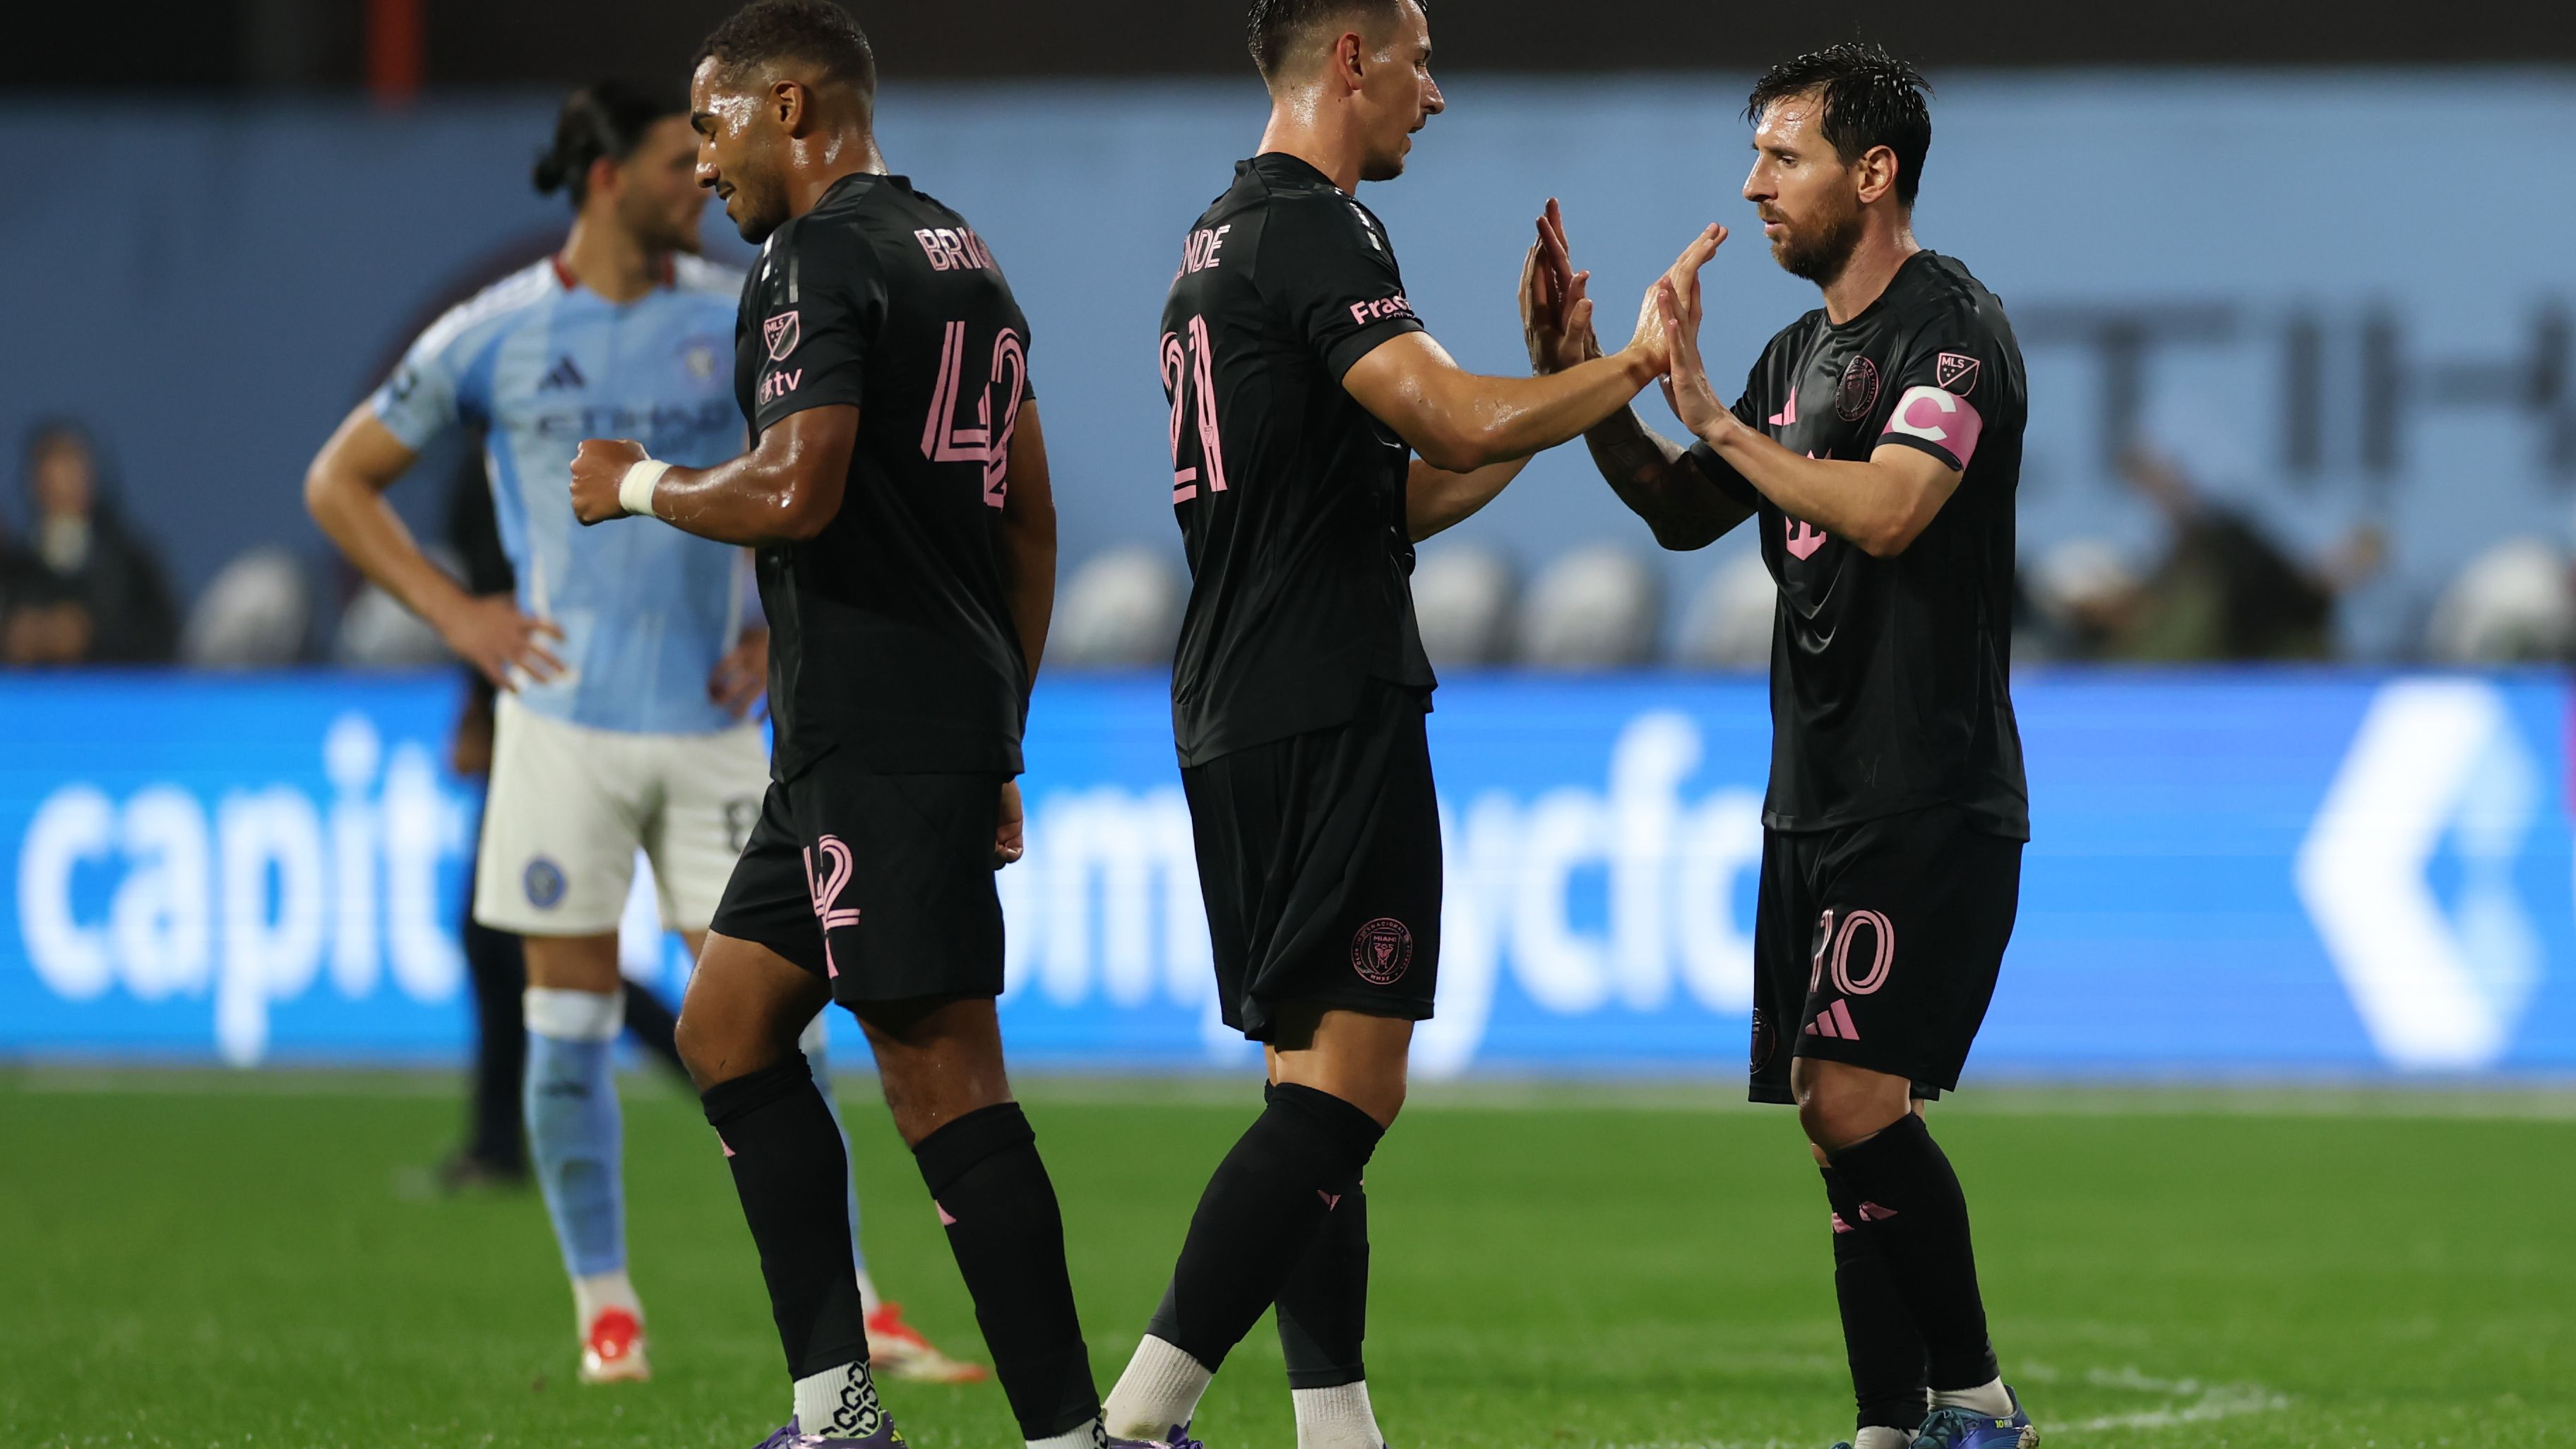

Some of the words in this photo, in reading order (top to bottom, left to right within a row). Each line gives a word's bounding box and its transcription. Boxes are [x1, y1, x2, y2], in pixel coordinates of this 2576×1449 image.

[767, 318, 785, 333] MLS
[773, 368, 803, 397] tv
[1942, 356, 1965, 369] MLS
[920, 321, 1027, 513] 42
[1891, 386, 1957, 441] C
[1810, 907, 1895, 996] 10
